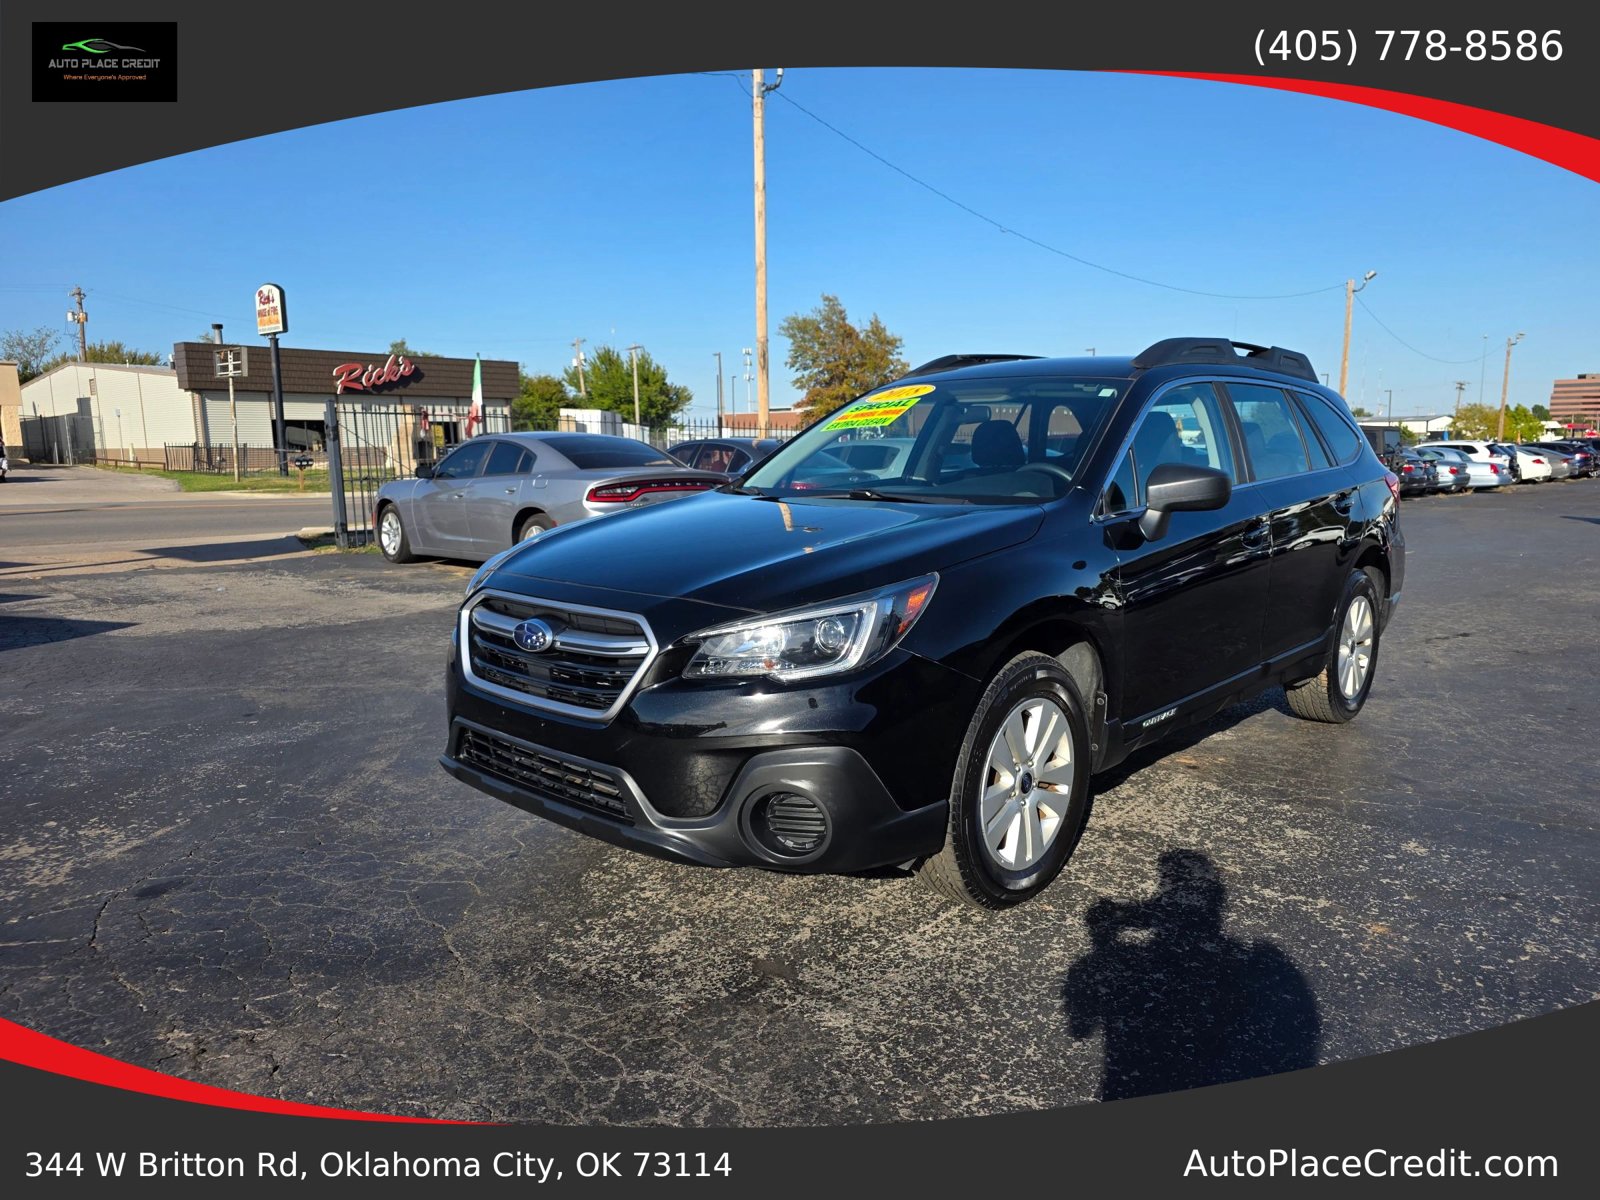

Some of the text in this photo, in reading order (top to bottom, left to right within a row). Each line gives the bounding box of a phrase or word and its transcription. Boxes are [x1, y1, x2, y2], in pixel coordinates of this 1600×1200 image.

[257, 288, 275, 306] Rick's
[333, 354, 415, 395] Rick's
[849, 399, 911, 412] SPECIAL
[855, 416, 892, 427] CLEAN
